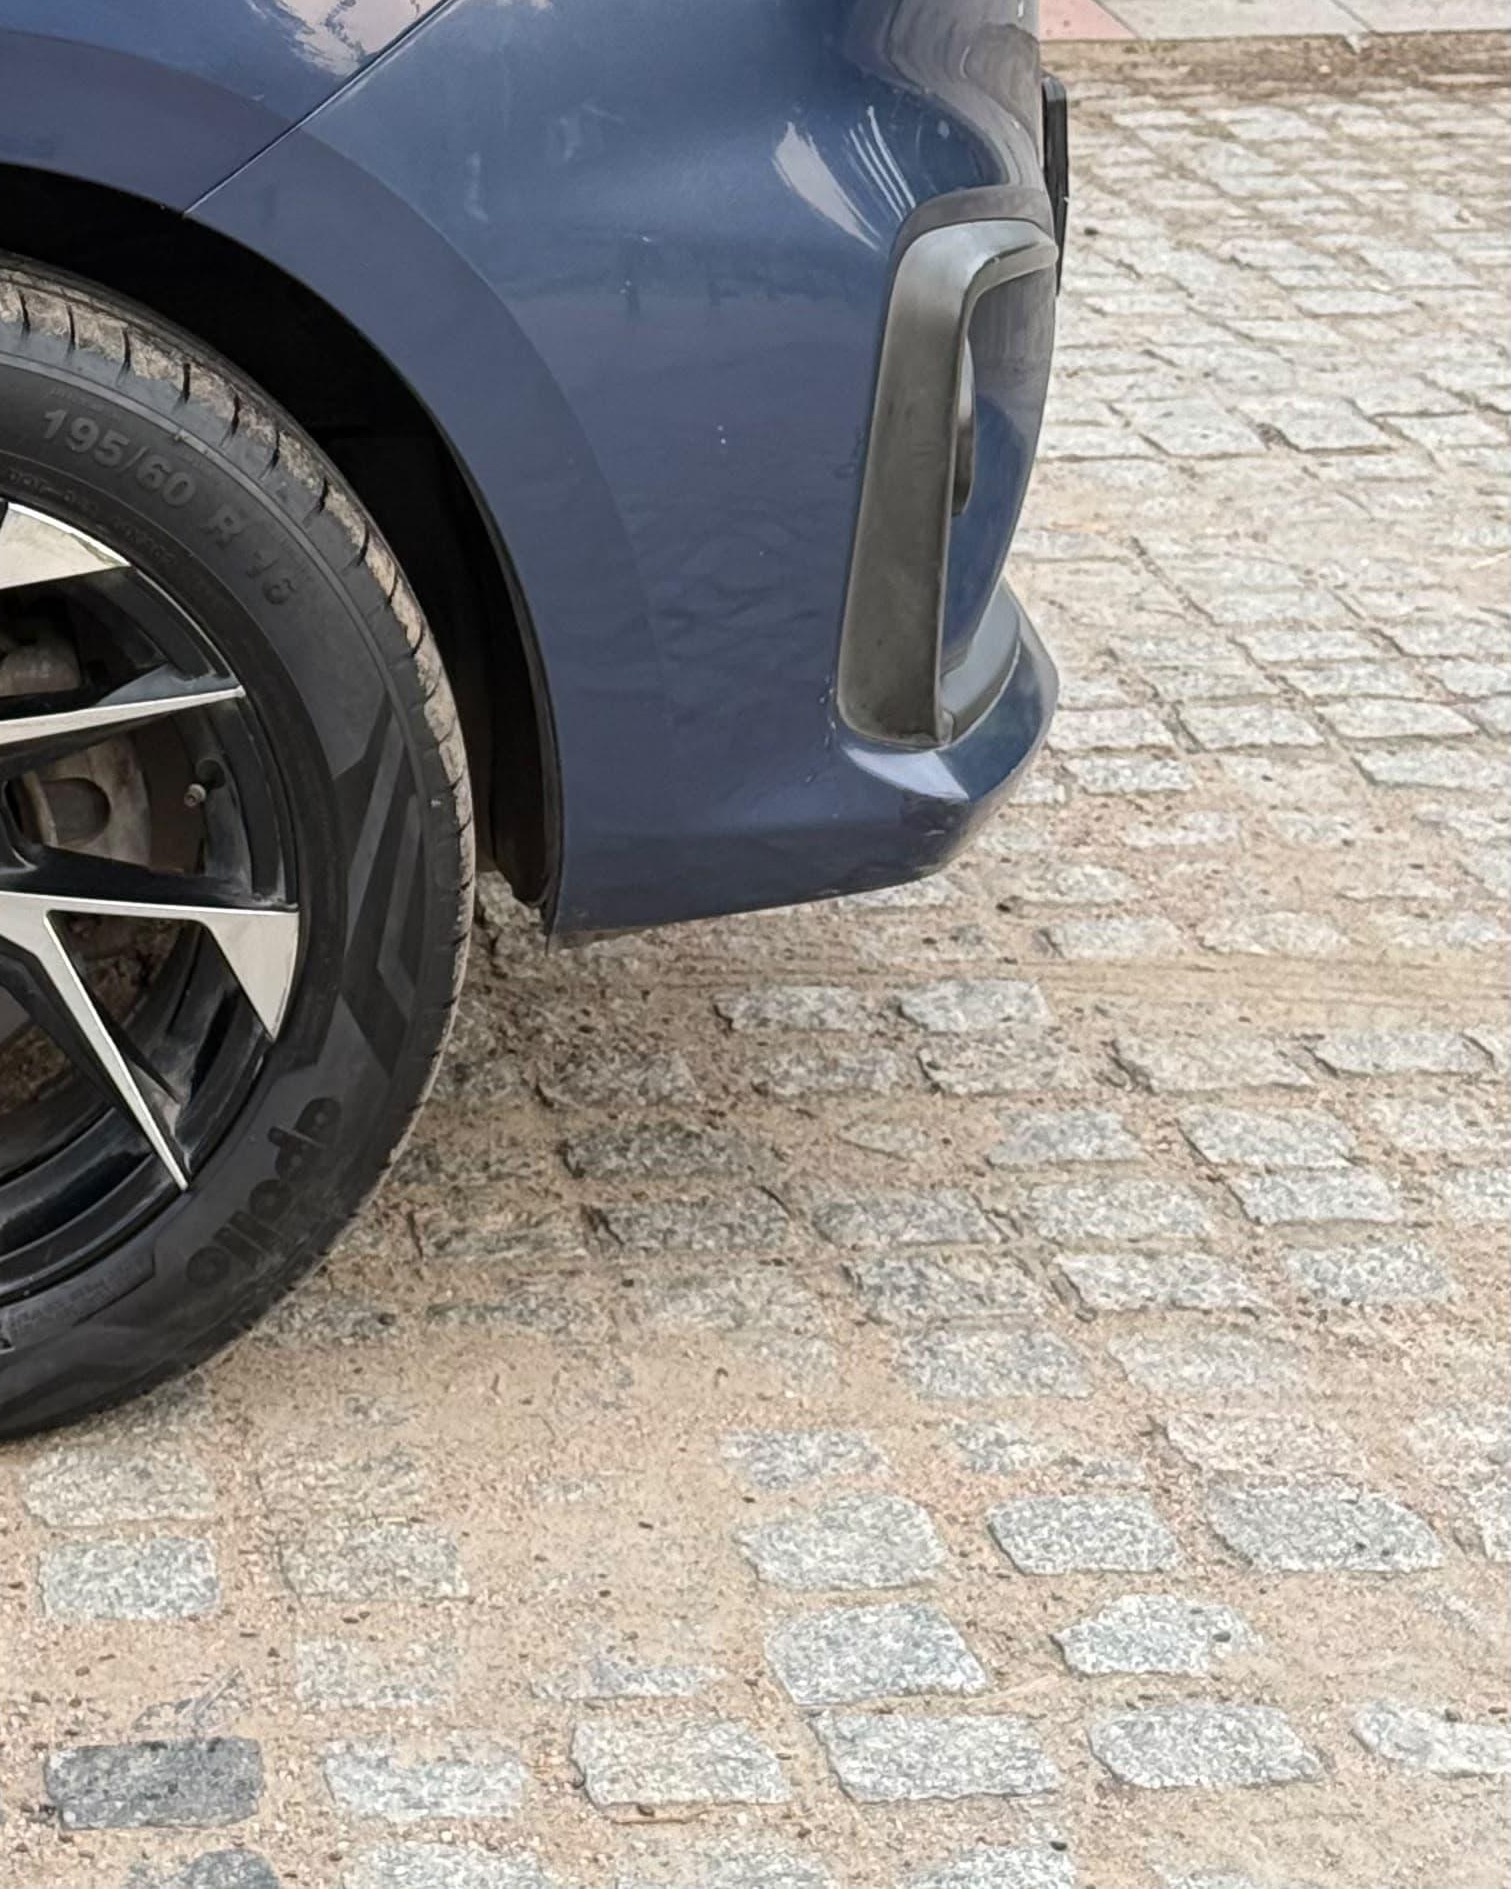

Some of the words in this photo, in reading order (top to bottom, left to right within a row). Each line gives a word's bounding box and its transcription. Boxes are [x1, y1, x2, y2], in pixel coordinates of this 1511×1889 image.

[41, 407, 198, 508] 195/60
[200, 508, 245, 548] R
[244, 549, 299, 606] 16
[185, 1096, 342, 1288] apollo
